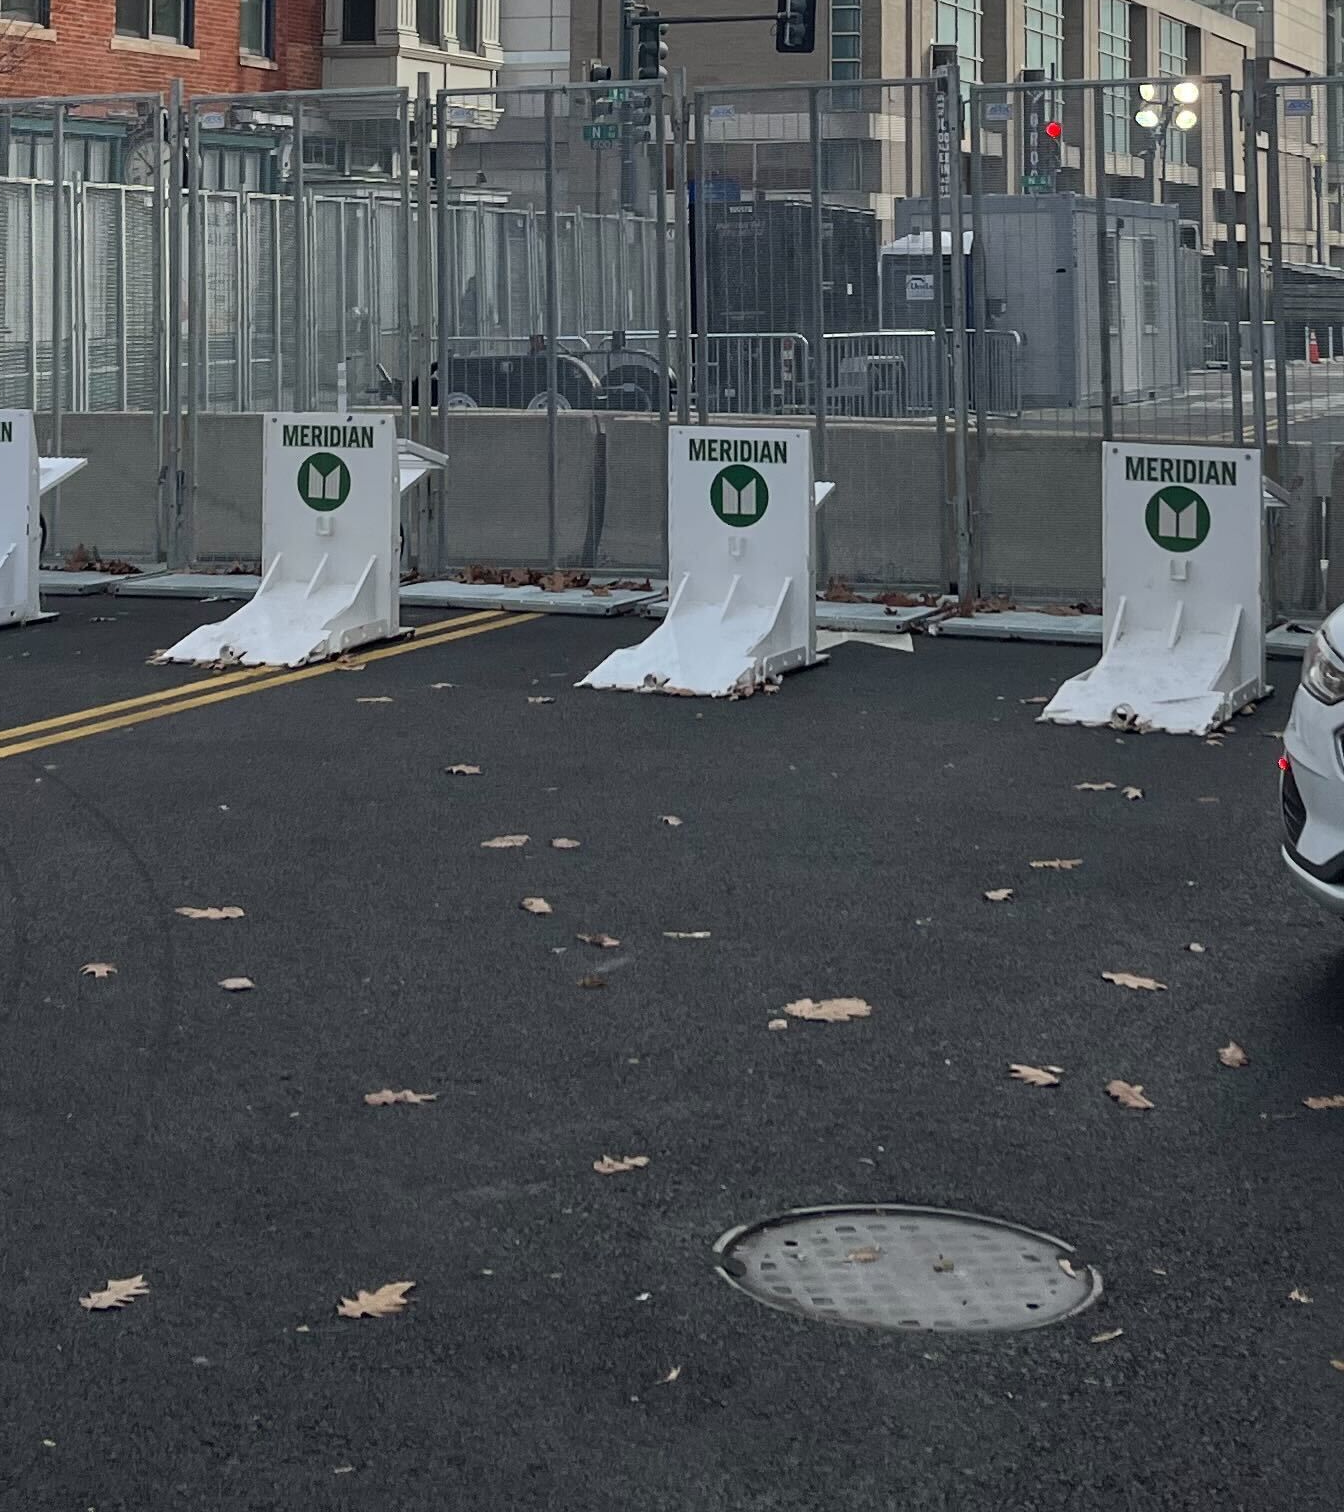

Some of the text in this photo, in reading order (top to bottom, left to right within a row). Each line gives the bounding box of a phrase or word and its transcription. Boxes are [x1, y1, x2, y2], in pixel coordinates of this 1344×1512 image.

[283, 425, 374, 448] MERIDIAN
[689, 438, 787, 464] MERIDIAN
[1125, 455, 1237, 486] MERIDIAN
